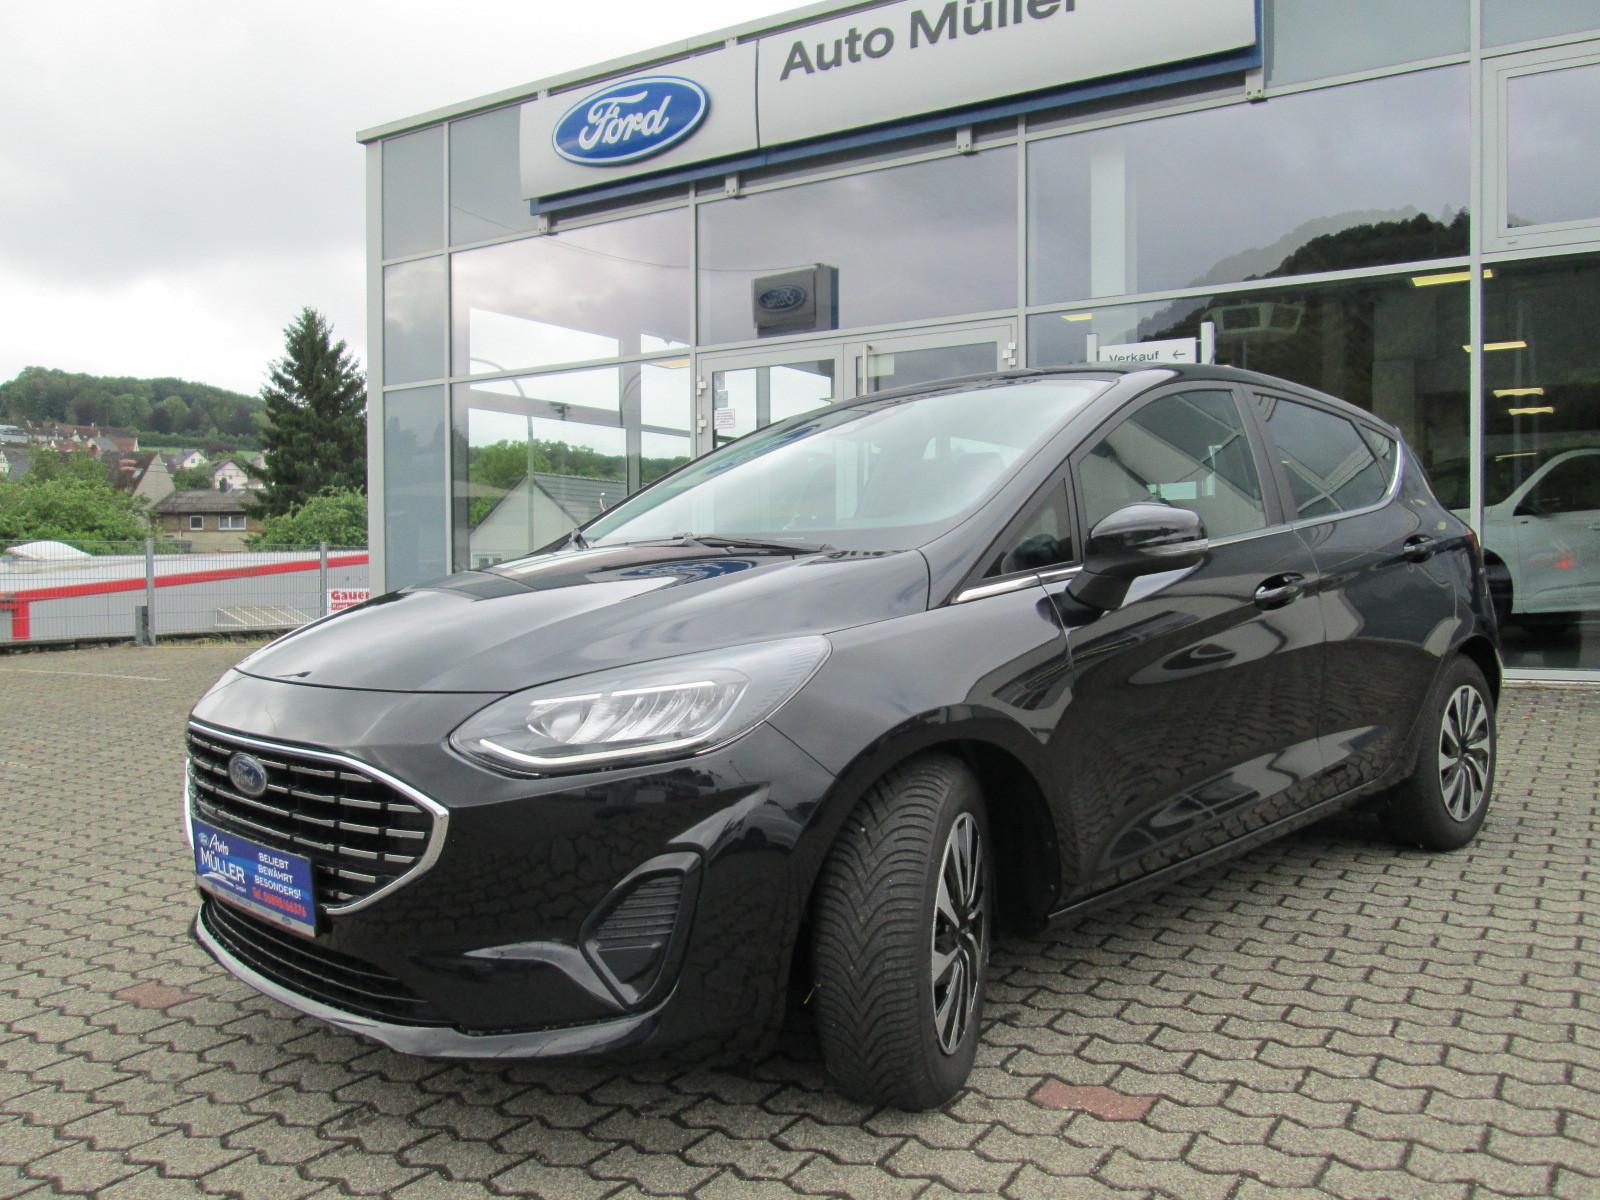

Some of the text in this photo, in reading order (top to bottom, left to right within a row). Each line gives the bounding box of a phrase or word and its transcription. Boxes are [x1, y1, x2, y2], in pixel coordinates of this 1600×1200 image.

[780, 27, 895, 81] Auto
[578, 90, 672, 150] Ford
[201, 846, 246, 885] MÜLLER
[258, 852, 289, 871] BELIEBT
[254, 874, 302, 901] BESONDERS!
